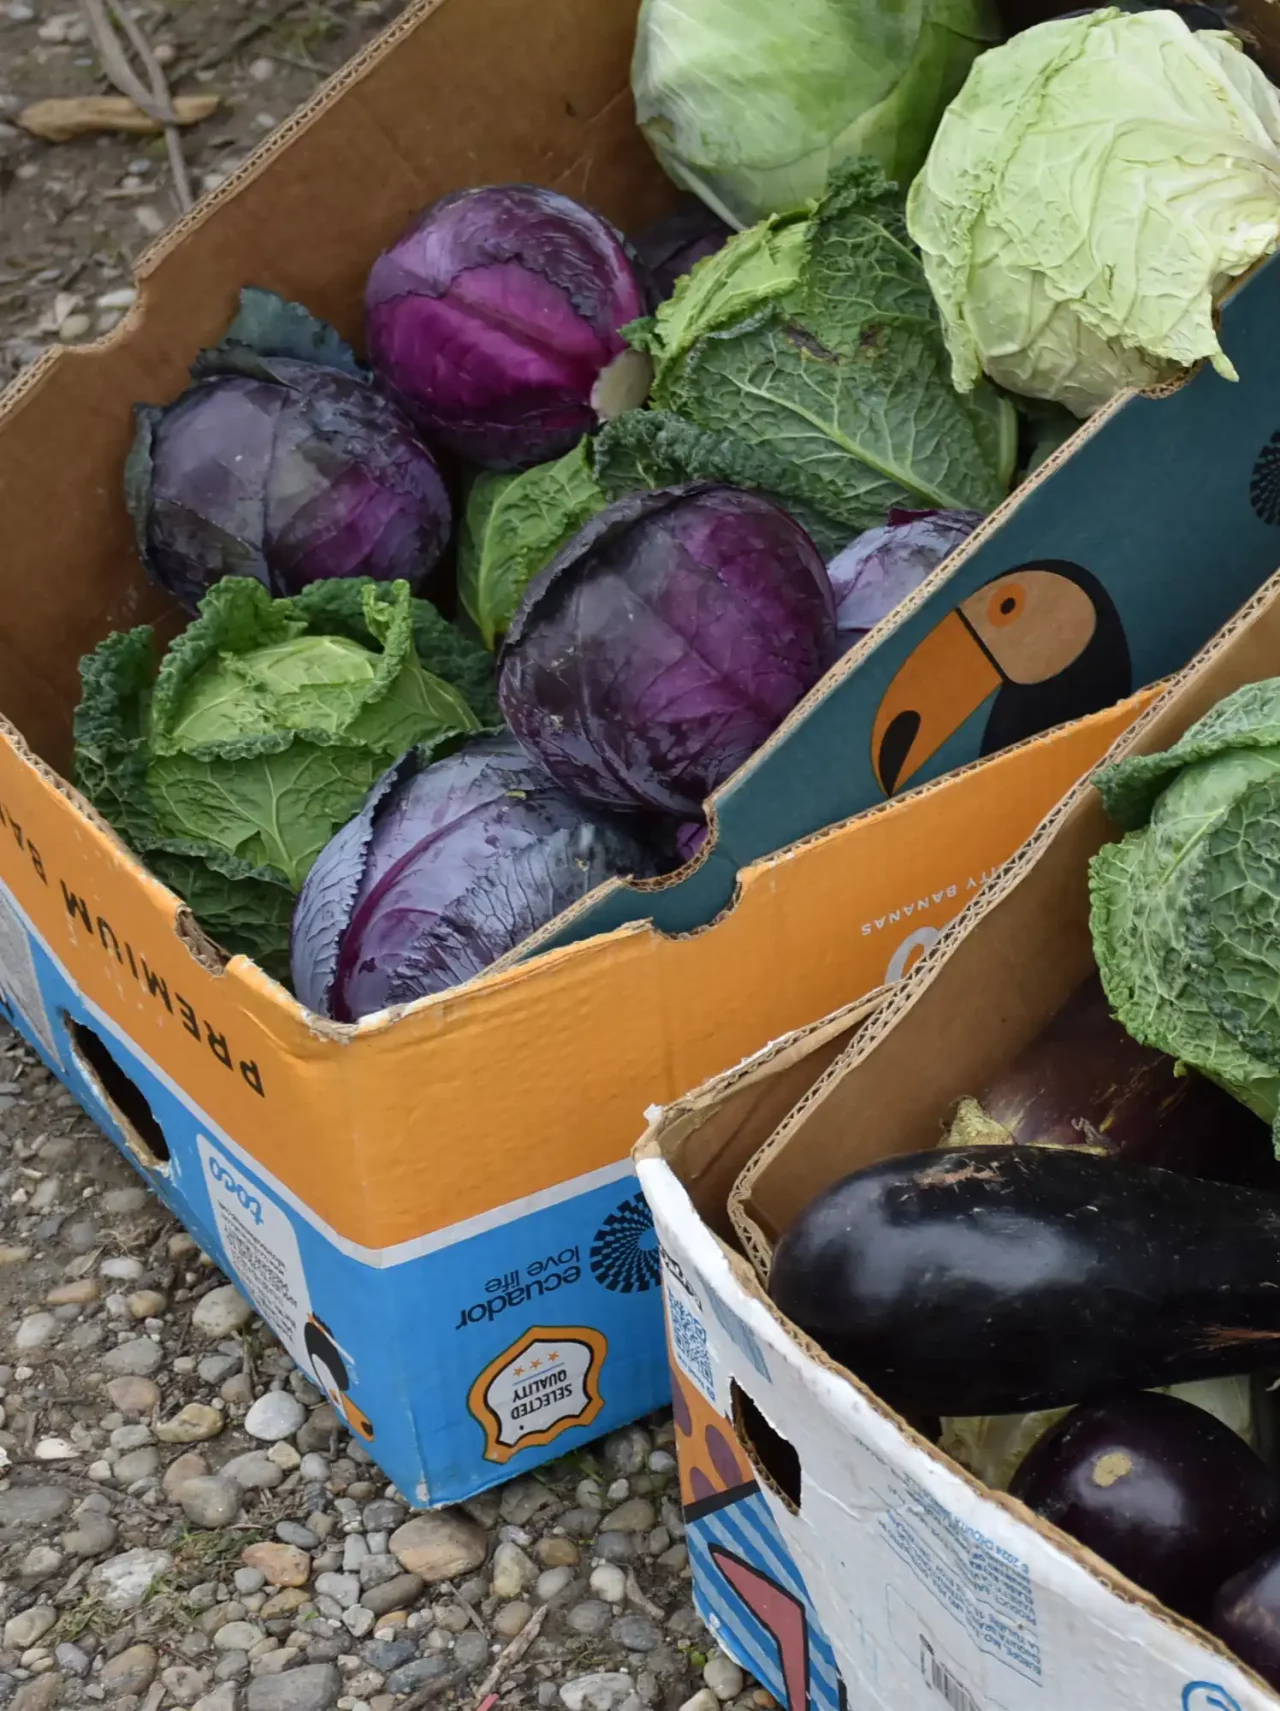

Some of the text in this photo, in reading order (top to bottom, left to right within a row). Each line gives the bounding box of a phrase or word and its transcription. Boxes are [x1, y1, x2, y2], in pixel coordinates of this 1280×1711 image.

[0, 802, 49, 887] BA
[860, 883, 957, 936] BANANAS
[59, 877, 266, 1099] PREMIUM
[484, 1245, 581, 1293] love life
[455, 1265, 582, 1330] ecuador
[510, 1382, 574, 1421] SELECTED
[512, 1368, 568, 1404] QUALITY
